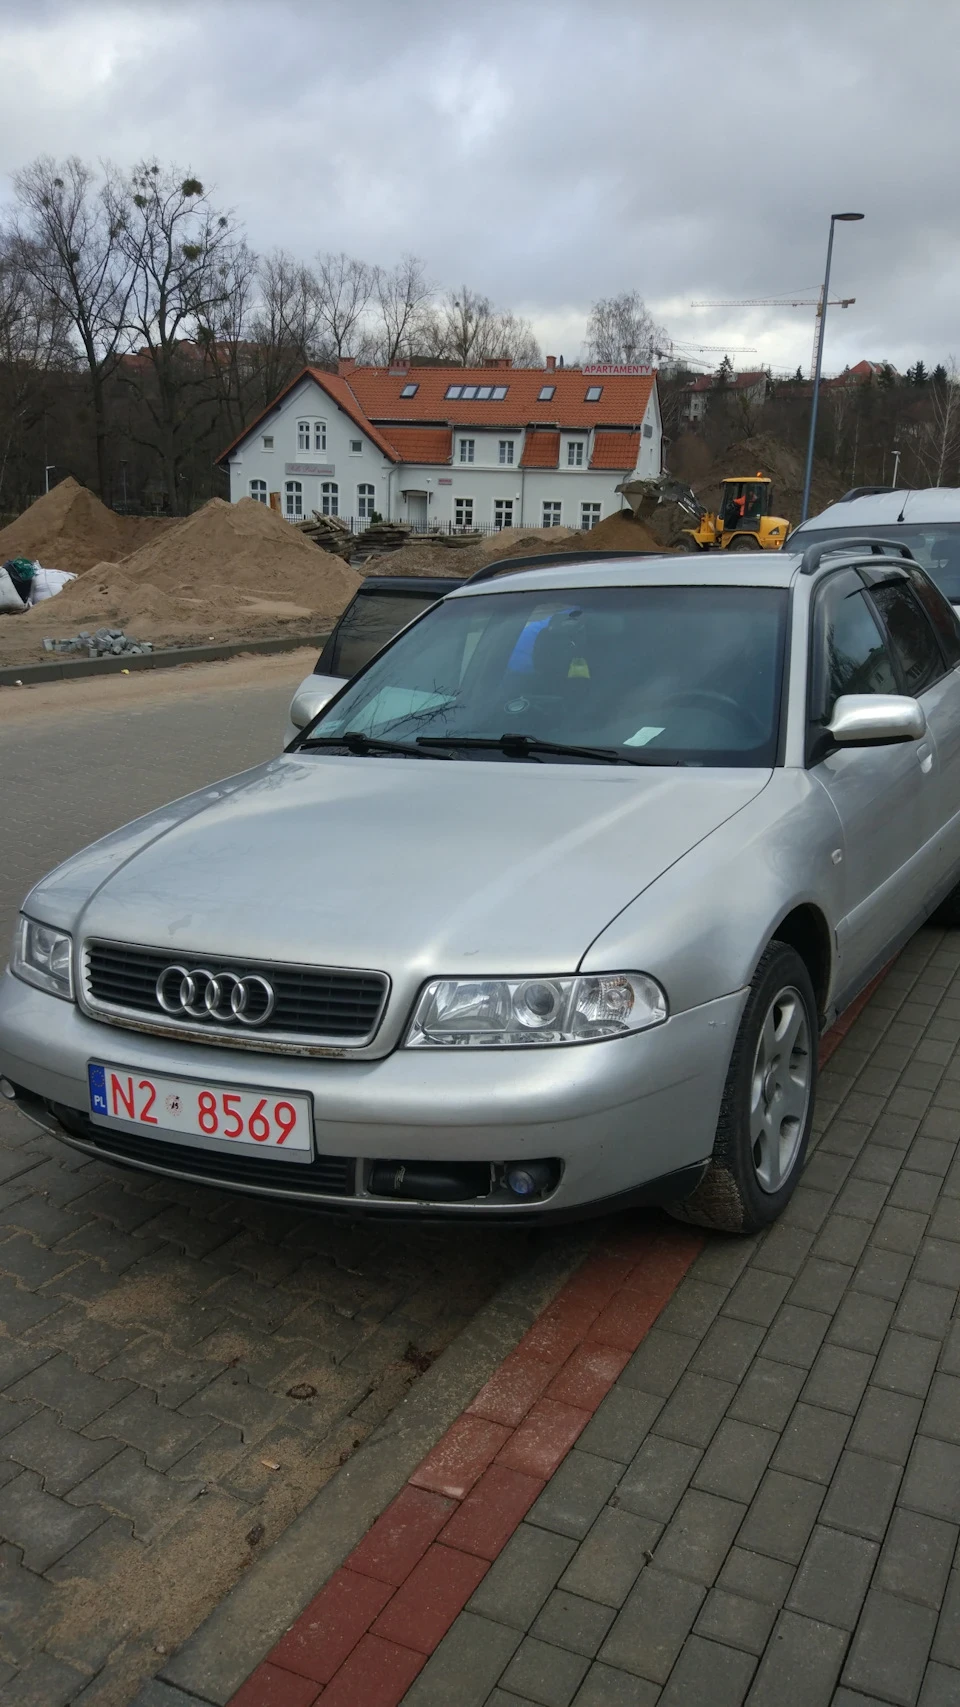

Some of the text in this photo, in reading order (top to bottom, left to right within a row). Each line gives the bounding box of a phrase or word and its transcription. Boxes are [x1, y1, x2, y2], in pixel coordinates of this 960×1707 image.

[584, 365, 650, 374] APARTAMENTY
[94, 1094, 106, 1108] PL
[111, 1073, 297, 1145] N2 8569
